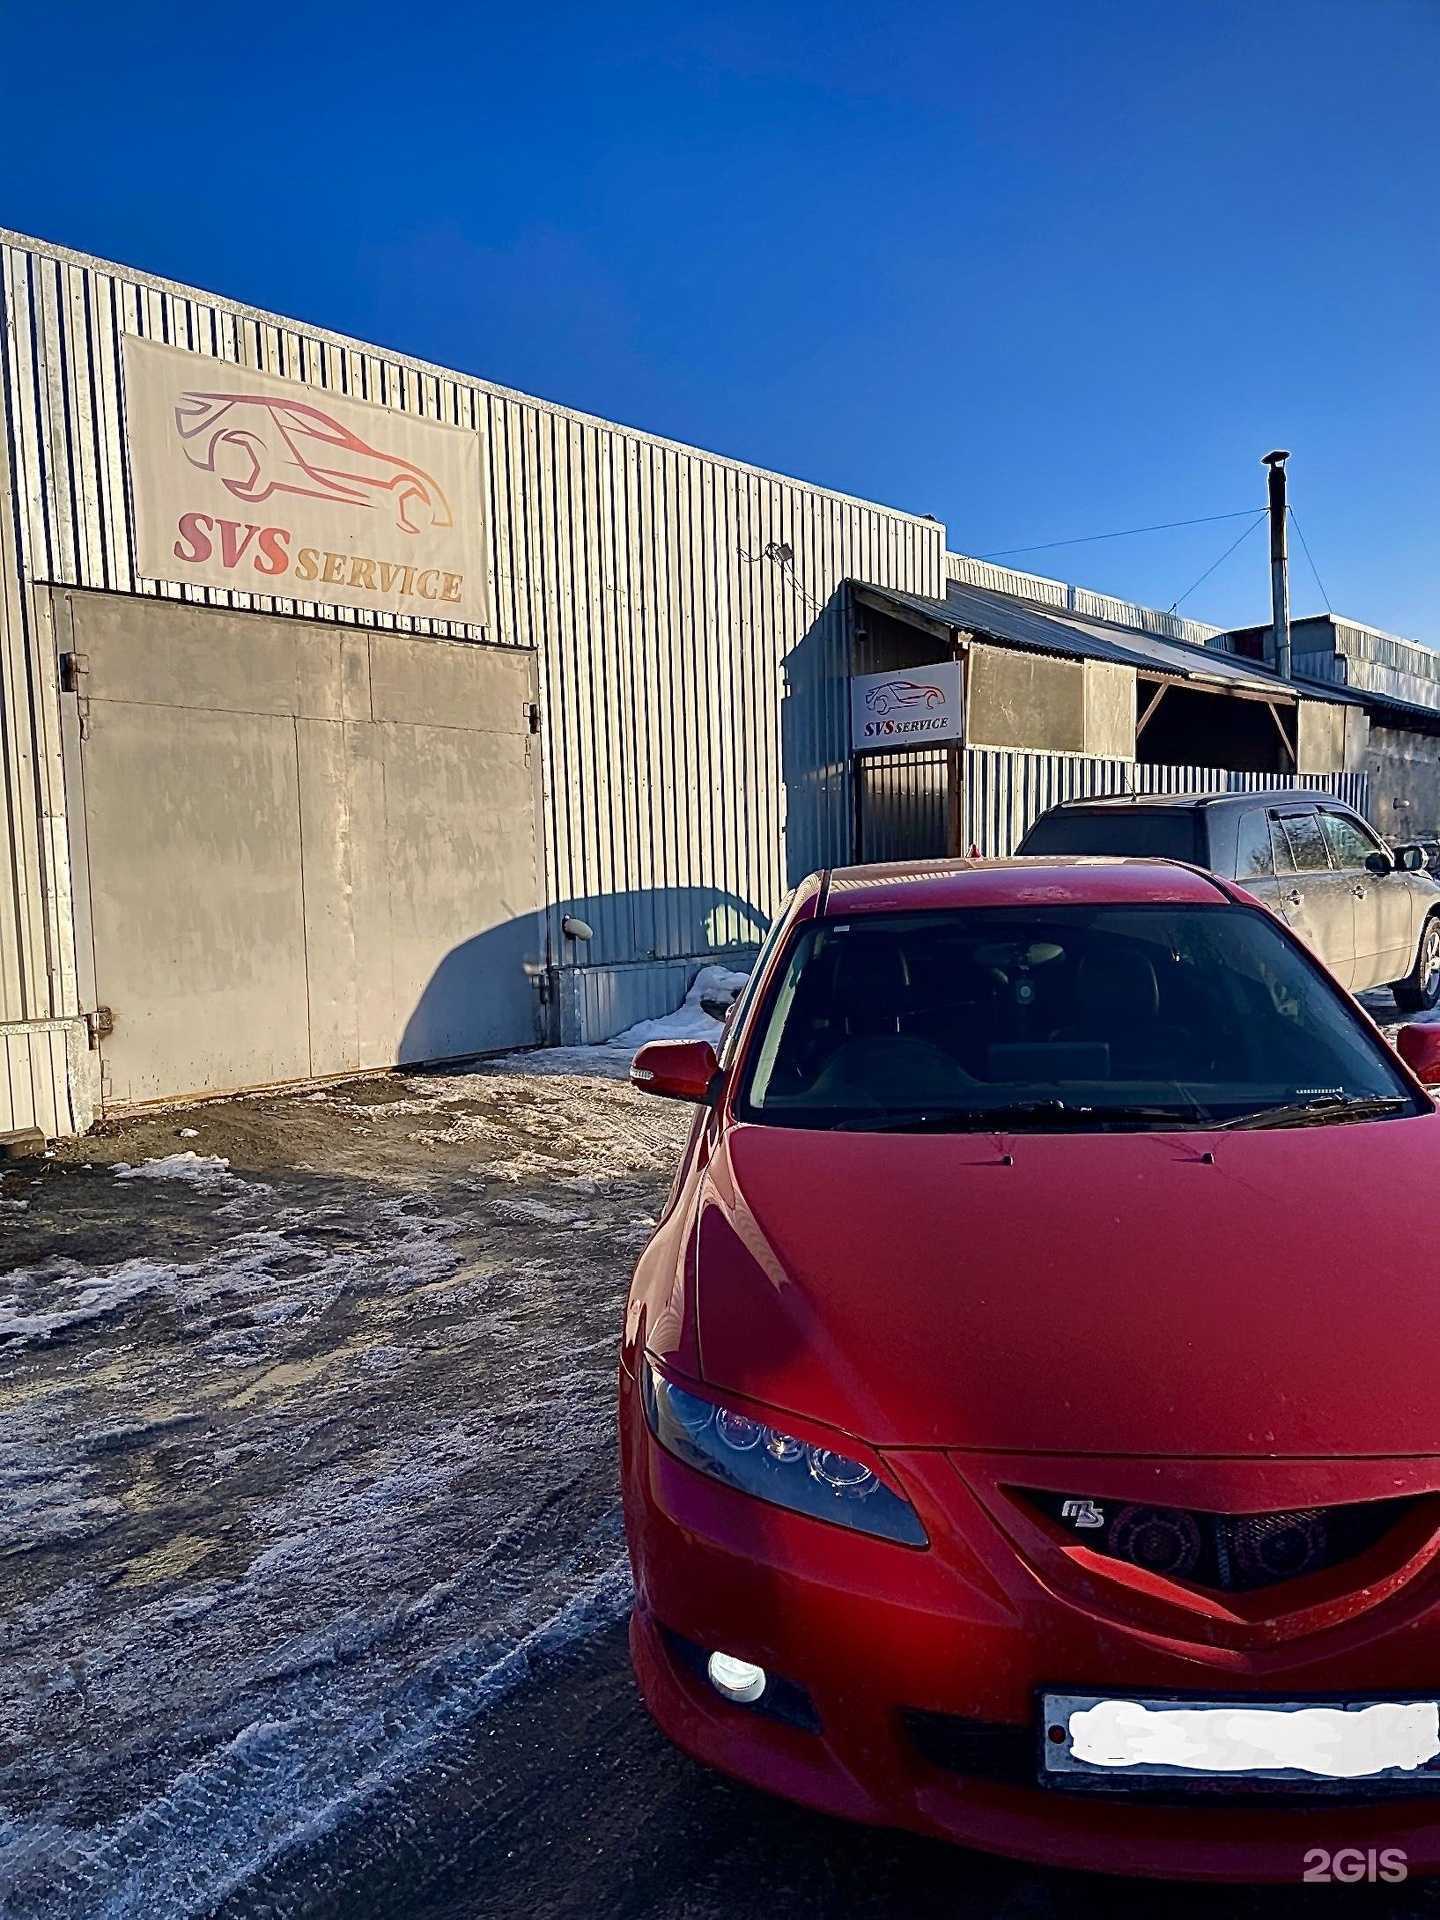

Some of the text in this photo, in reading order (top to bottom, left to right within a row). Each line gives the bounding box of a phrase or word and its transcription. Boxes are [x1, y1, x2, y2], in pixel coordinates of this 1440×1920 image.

[174, 512, 464, 603] SVS SERVICE
[864, 717, 949, 737] SVS SERVICE
